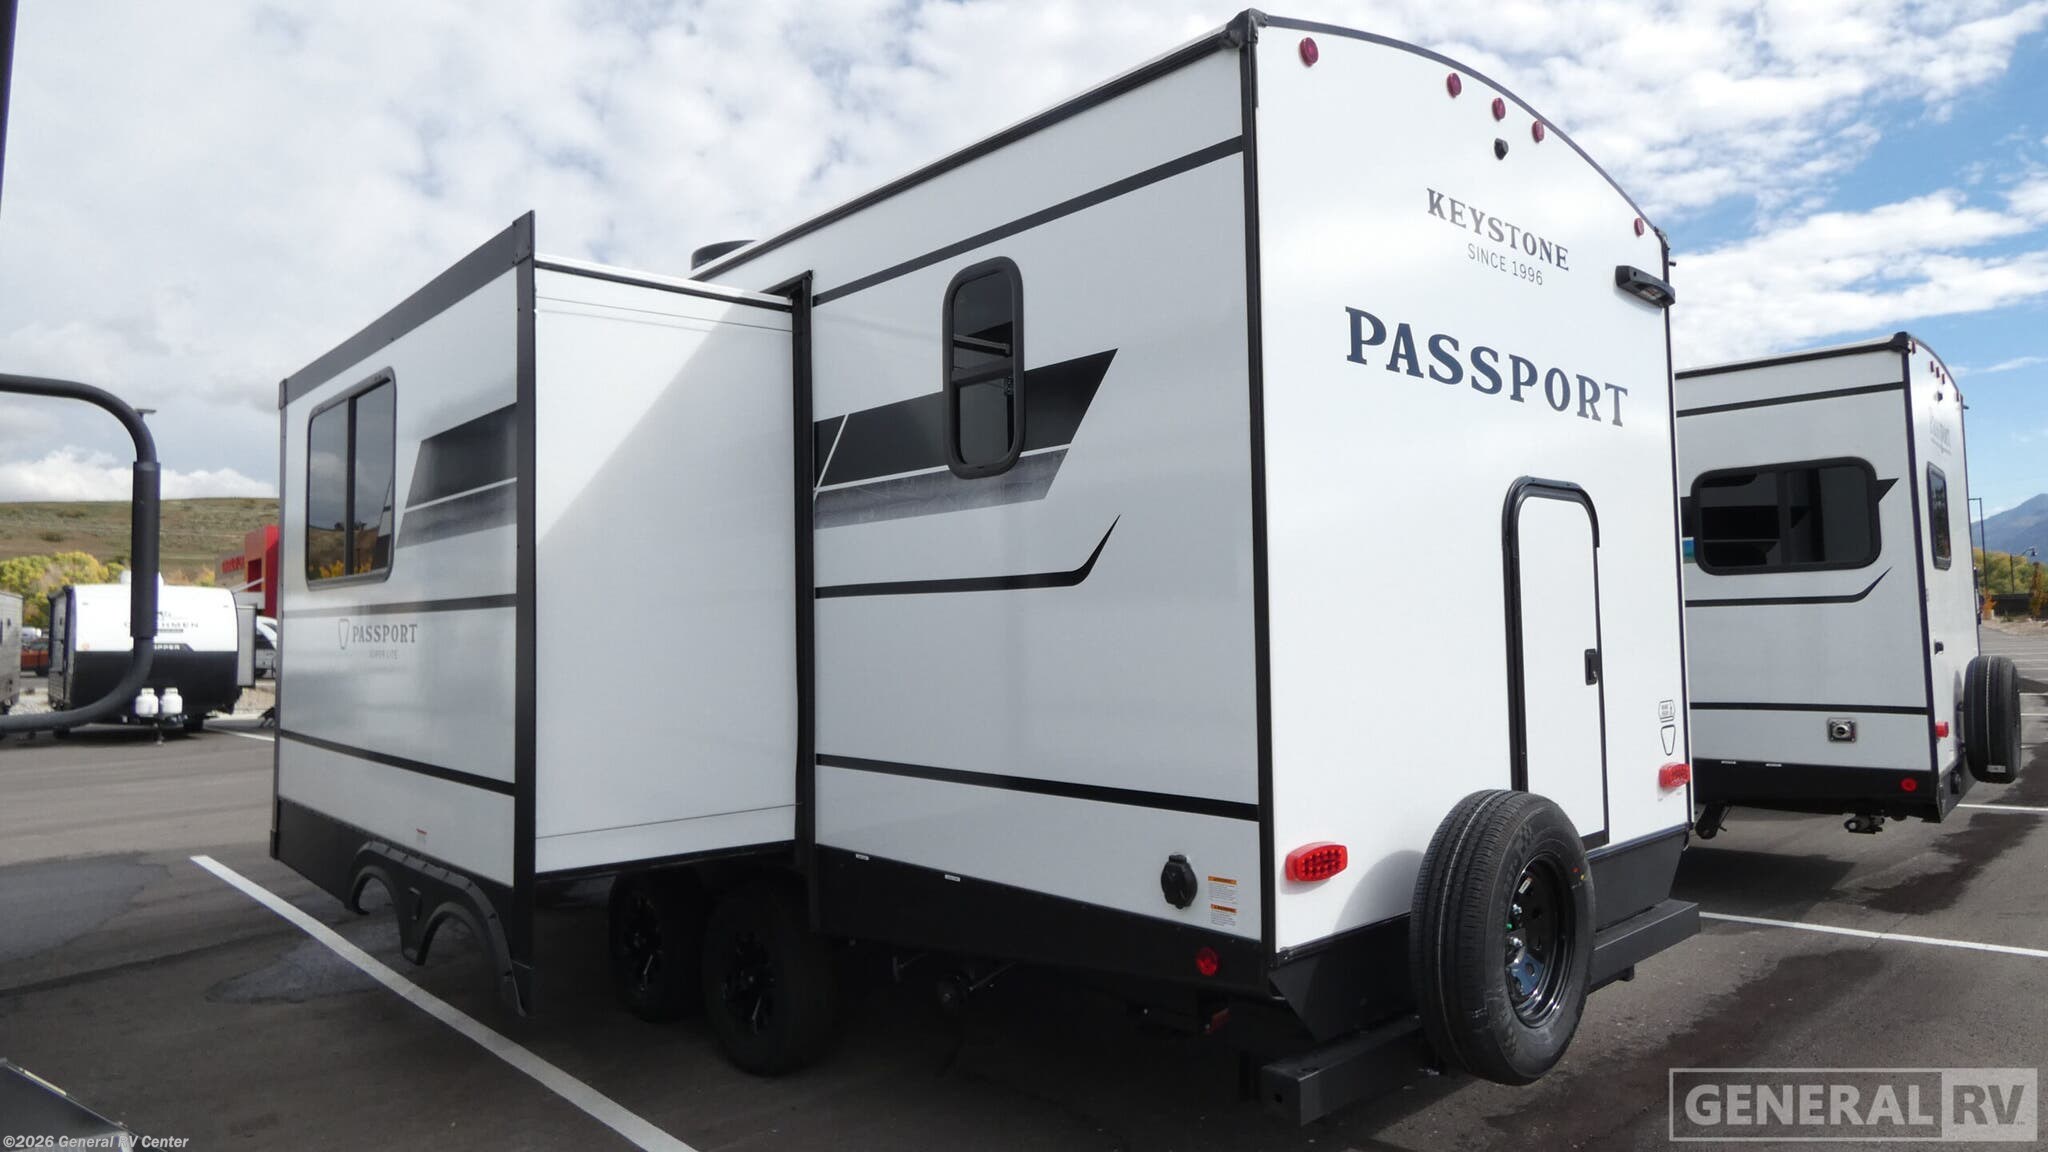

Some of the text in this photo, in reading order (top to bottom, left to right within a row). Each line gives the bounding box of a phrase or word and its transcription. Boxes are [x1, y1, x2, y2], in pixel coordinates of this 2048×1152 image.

[1426, 187, 1570, 272] KEYSTONE
[1467, 242, 1544, 286] SINCE 1996
[1345, 305, 1629, 427] PASSPORT
[352, 624, 418, 643] PASSPORT
